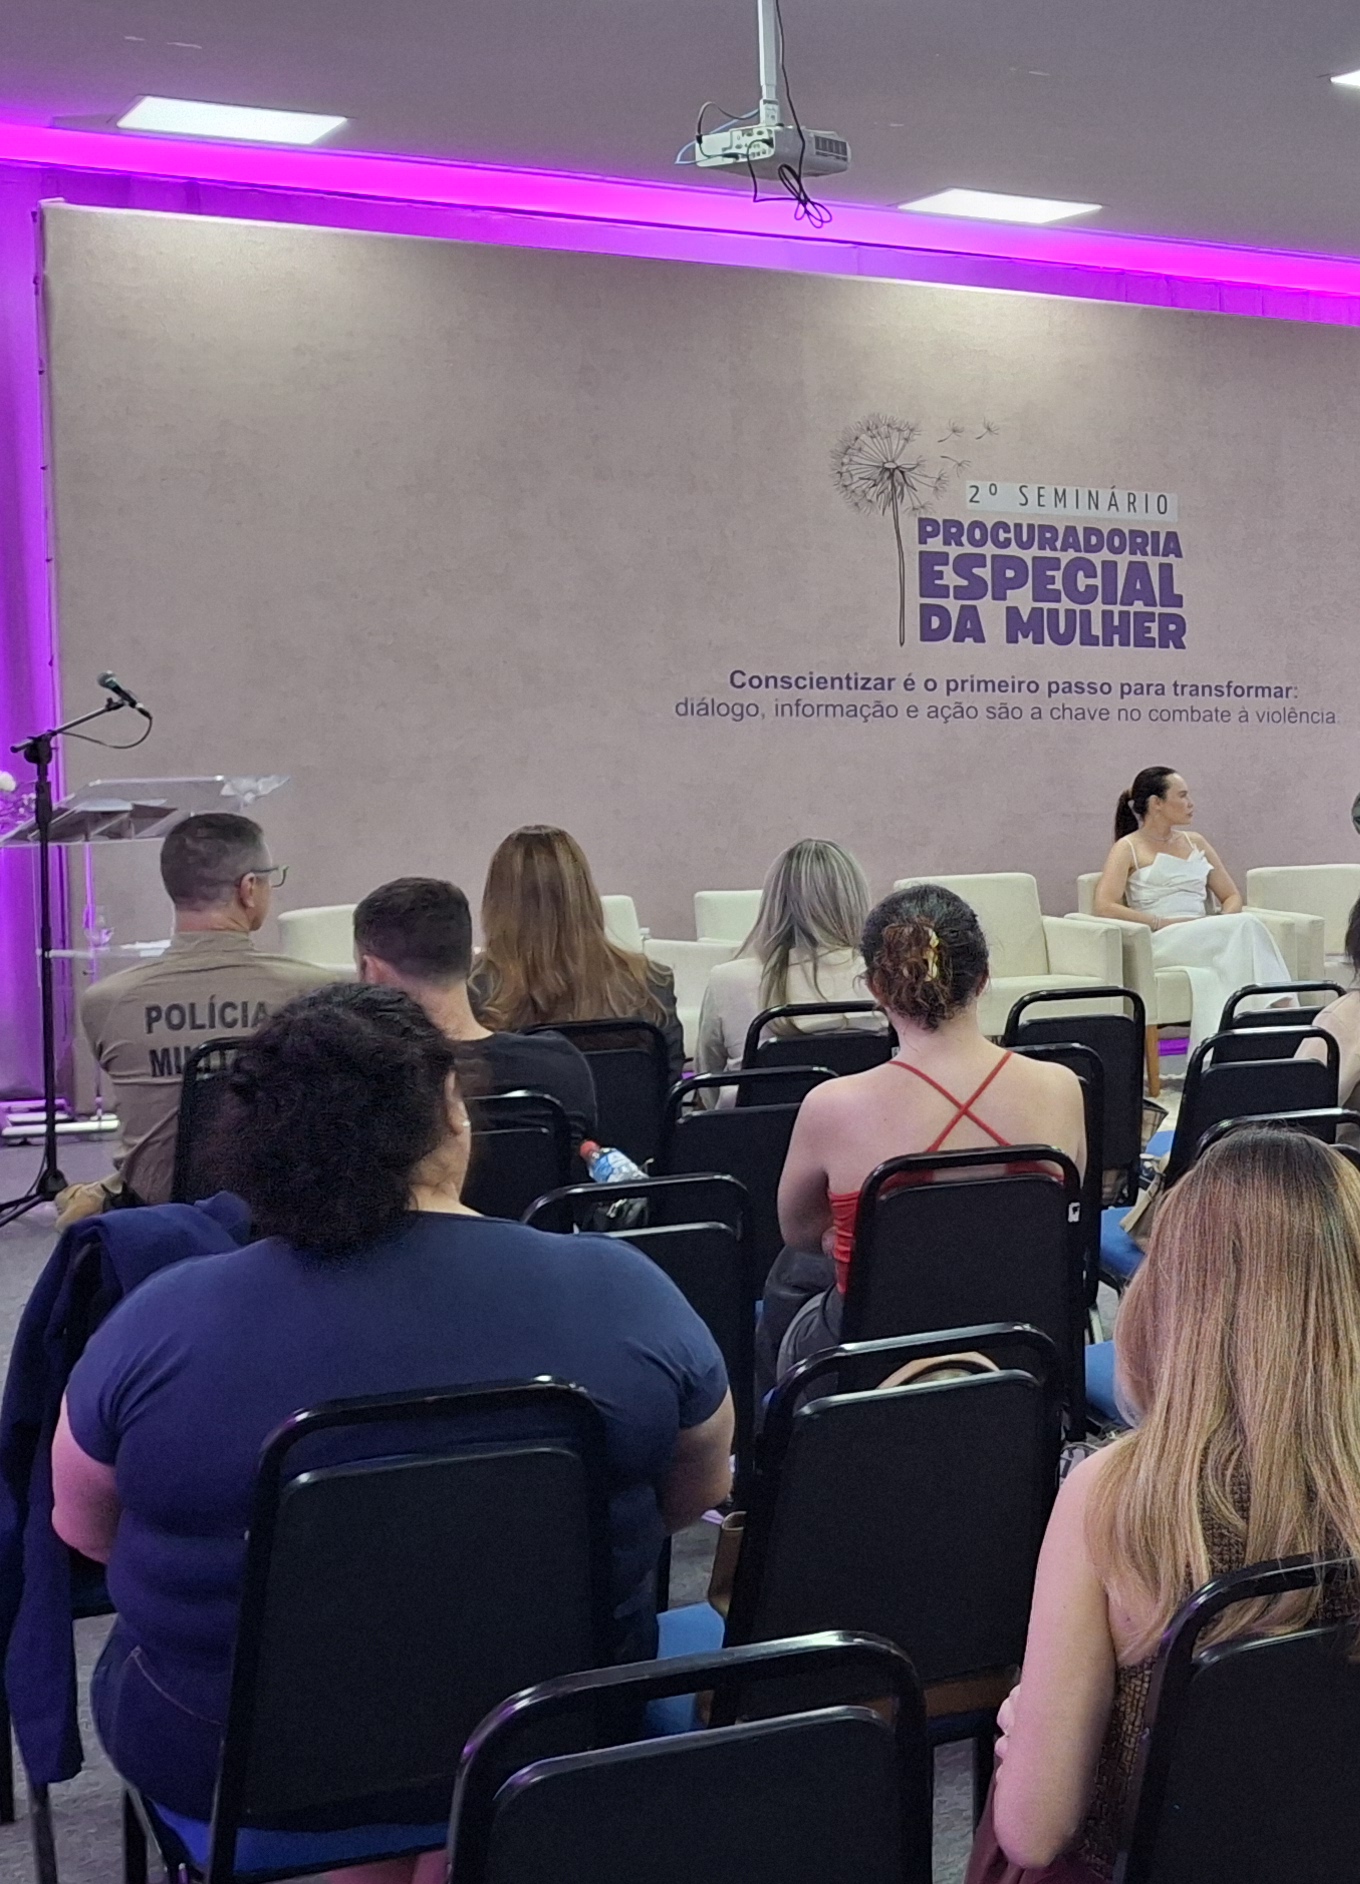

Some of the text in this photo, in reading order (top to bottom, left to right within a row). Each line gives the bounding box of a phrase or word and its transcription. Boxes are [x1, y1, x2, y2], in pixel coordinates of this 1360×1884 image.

[968, 483, 1168, 515] 2º SEMINÁRIO
[917, 517, 1184, 559] PROCURADORIA
[918, 550, 1184, 608] ESPECIAL
[919, 603, 1187, 650] DA MULHER
[729, 669, 1299, 699] Conscientizar é o primeiro passo para transformar:
[674, 697, 766, 722] diálogo,
[774, 698, 899, 722] informação
[906, 703, 919, 719] e
[926, 701, 979, 723] ação
[986, 702, 1023, 720] são
[1030, 705, 1042, 720] a
[1049, 703, 1110, 721] chave
[1117, 707, 1142, 721] no
[1148, 705, 1232, 723] combate
[1238, 706, 1249, 723] à
